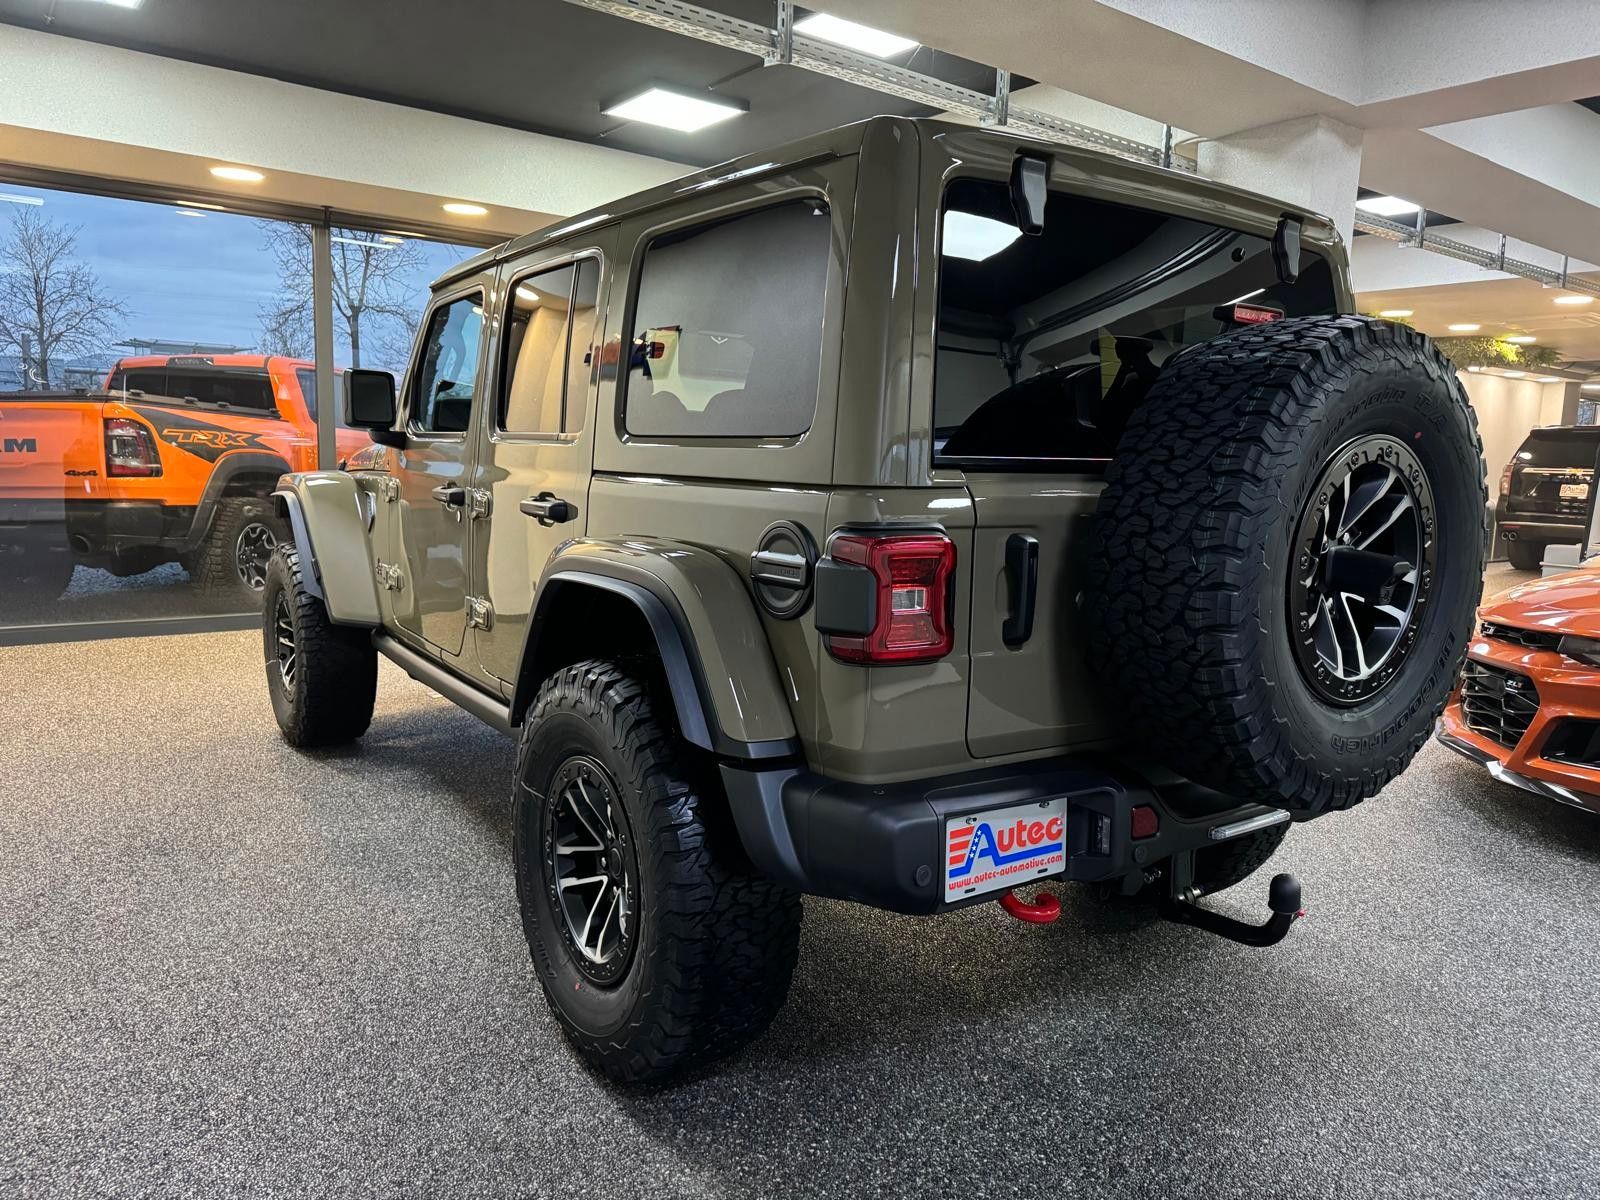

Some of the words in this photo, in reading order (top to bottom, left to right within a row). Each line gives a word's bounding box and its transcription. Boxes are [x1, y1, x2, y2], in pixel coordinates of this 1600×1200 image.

[0, 438, 37, 453] M
[162, 428, 253, 448] TRX
[949, 817, 1063, 878] Autec
[948, 854, 1063, 891] www.autec-automotive.com
